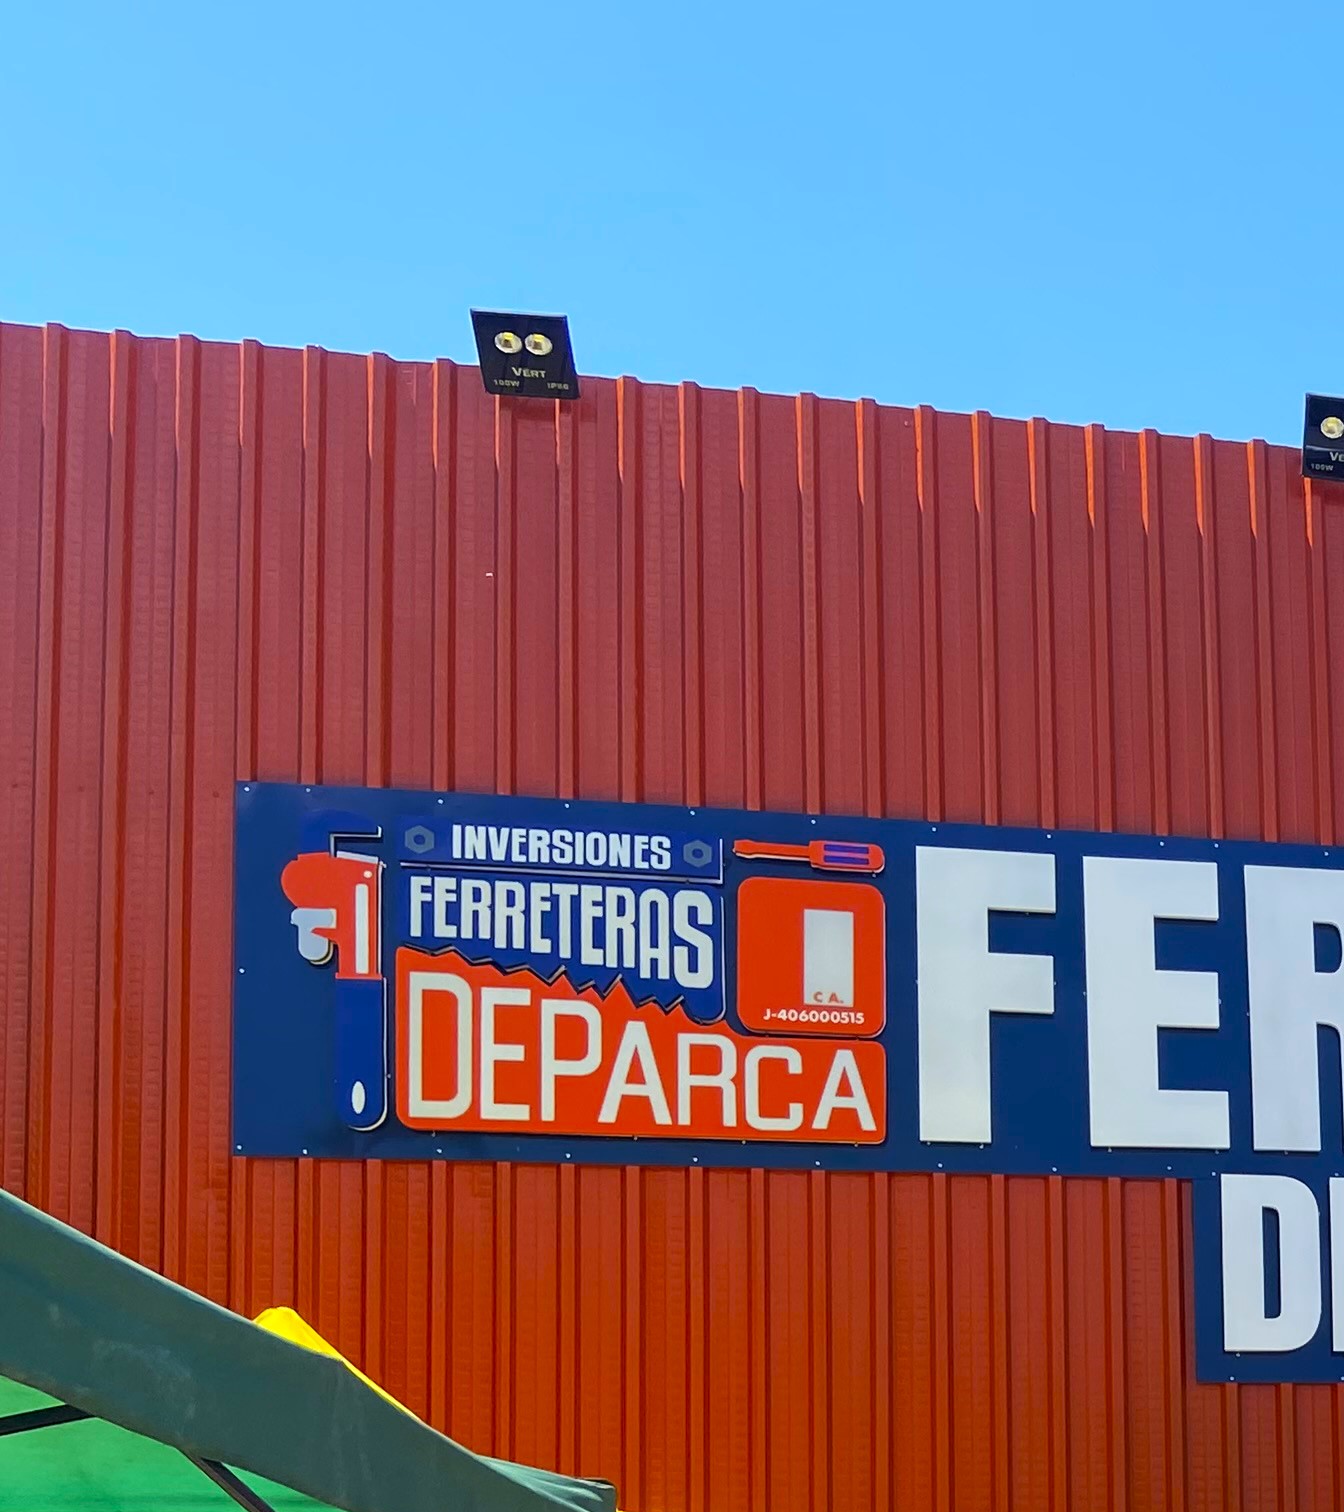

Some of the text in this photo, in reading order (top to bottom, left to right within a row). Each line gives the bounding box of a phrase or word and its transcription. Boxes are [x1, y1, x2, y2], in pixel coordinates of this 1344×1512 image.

[451, 824, 672, 870] INVERSIONES
[409, 875, 714, 989] FERRETERAS
[408, 971, 877, 1132] DEPARCA
[763, 1007, 866, 1025] J-406000515
